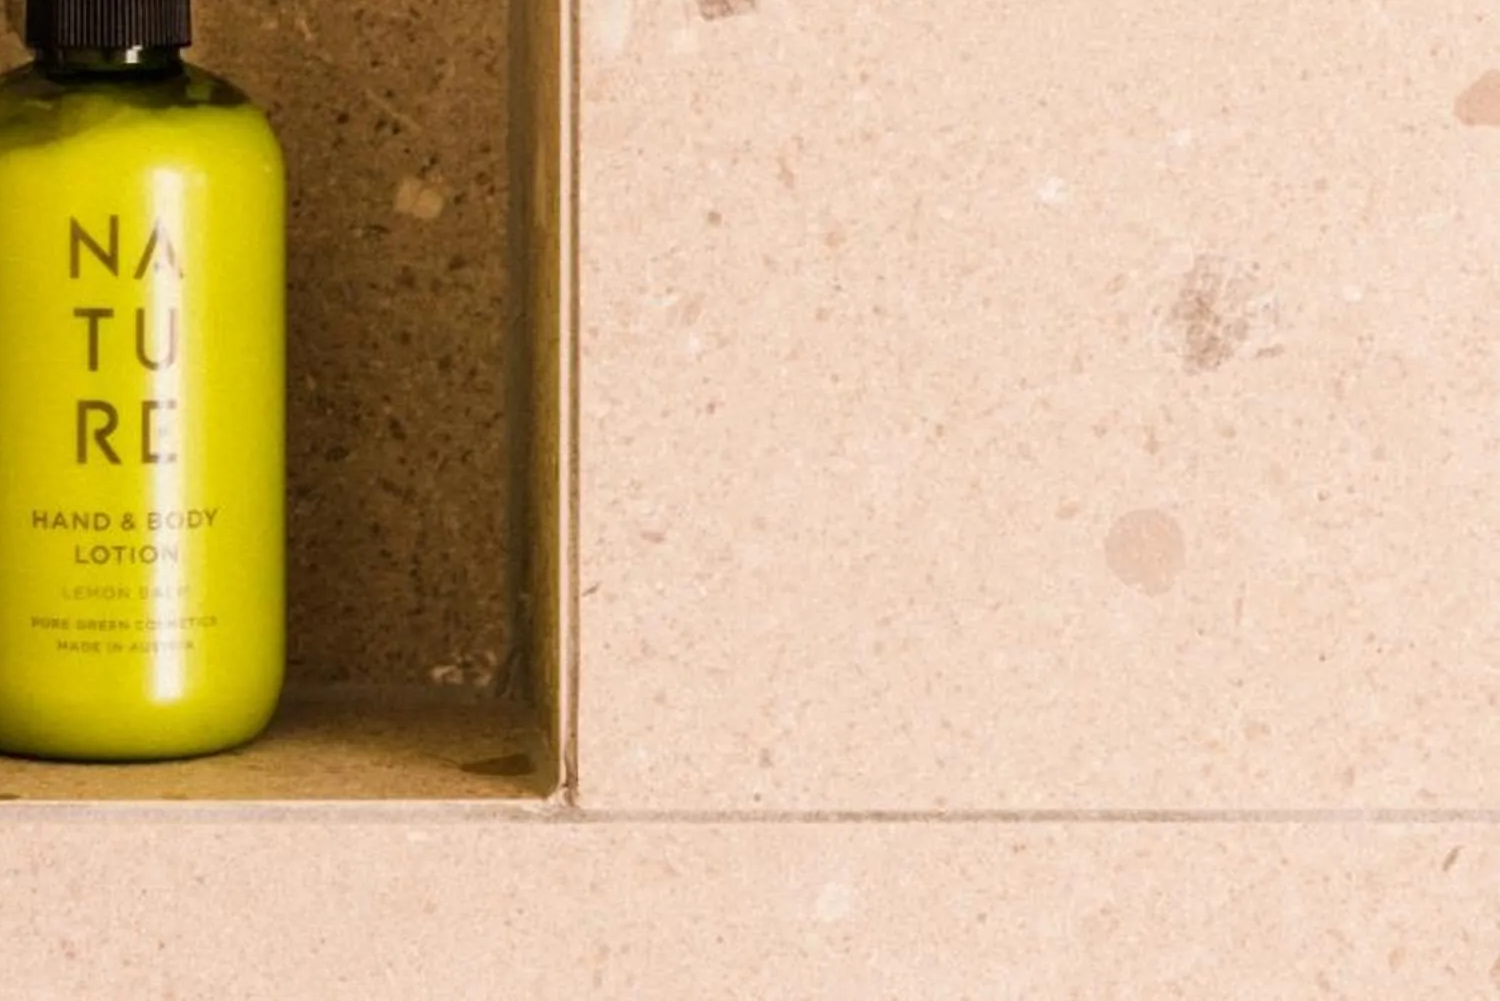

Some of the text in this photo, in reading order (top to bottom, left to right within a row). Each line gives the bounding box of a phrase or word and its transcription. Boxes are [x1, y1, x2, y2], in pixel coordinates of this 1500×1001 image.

[69, 214, 185, 280] NA
[73, 307, 177, 372] TU
[76, 400, 178, 465] RE
[32, 508, 219, 531] HAND & BODY
[74, 545, 180, 565] LOTION
[62, 586, 131, 601] LEMON
[31, 615, 69, 630] PURE
[134, 615, 218, 631] COMETICS
[57, 641, 101, 653] MADE
[129, 640, 195, 653] AUSA
